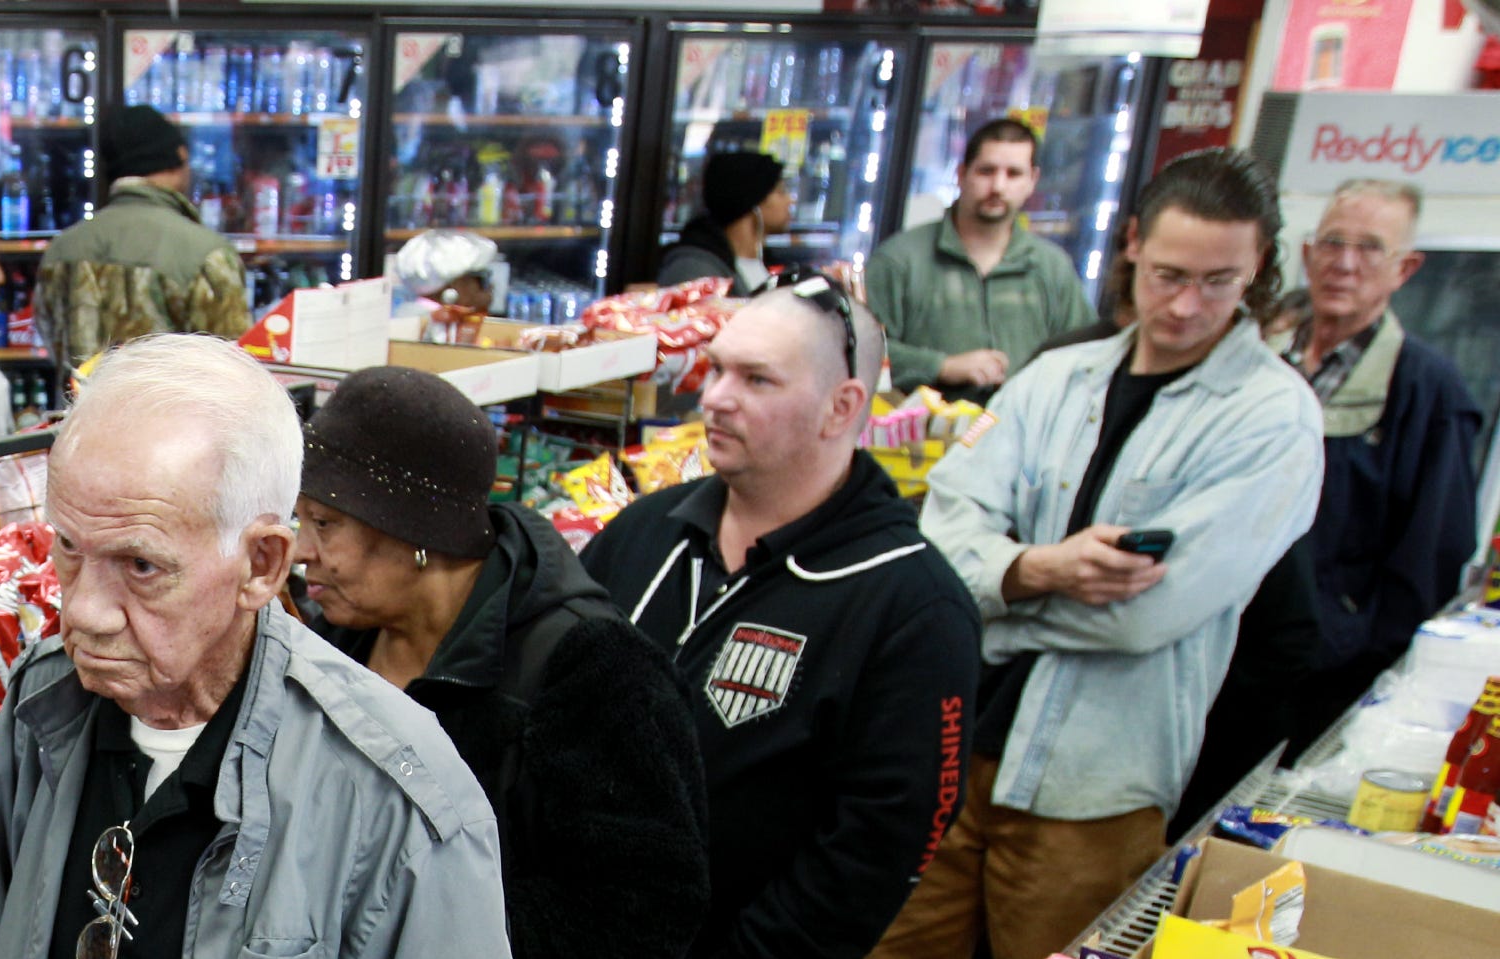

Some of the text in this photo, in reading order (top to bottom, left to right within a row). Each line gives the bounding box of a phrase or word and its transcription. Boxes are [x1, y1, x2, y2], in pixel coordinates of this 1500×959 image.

[60, 46, 89, 103] 6
[332, 47, 364, 104] 7
[596, 51, 623, 107] 8
[1169, 58, 1243, 88] GRAB
[918, 695, 963, 873] SHINEDOWN
